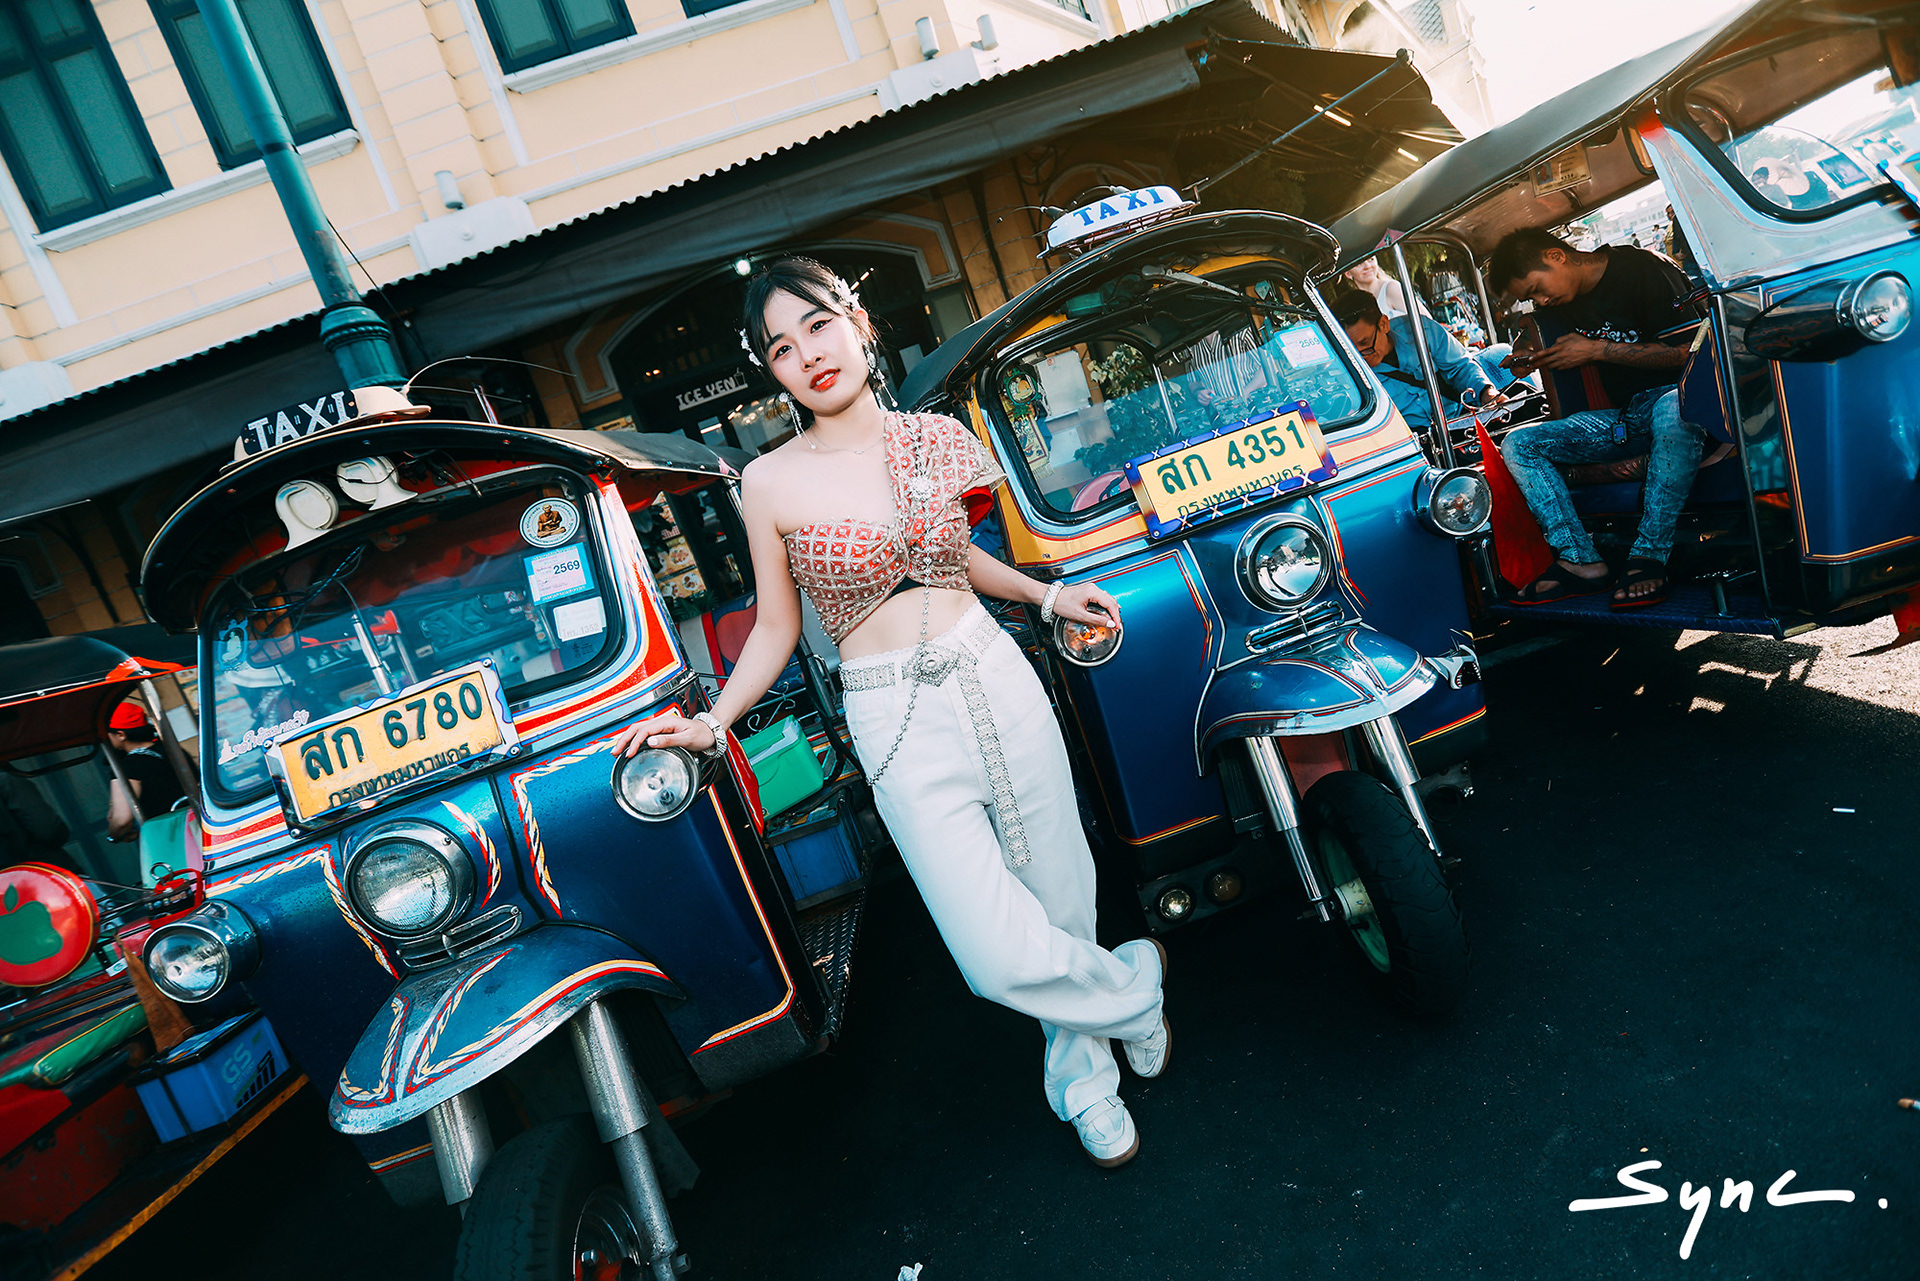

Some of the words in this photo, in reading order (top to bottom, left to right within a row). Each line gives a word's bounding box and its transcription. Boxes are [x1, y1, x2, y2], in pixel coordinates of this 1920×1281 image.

[1073, 187, 1164, 227] TAXI
[1299, 337, 1321, 348] 2569
[675, 387, 705, 407] ICE
[705, 376, 737, 397] YEN
[247, 390, 351, 451] TAXI
[1156, 453, 1213, 496] สก
[1226, 419, 1306, 470] 4351
[553, 559, 581, 575] 2569
[300, 725, 366, 781] สก
[382, 682, 484, 749] 6780
[221, 1042, 252, 1084] GS
